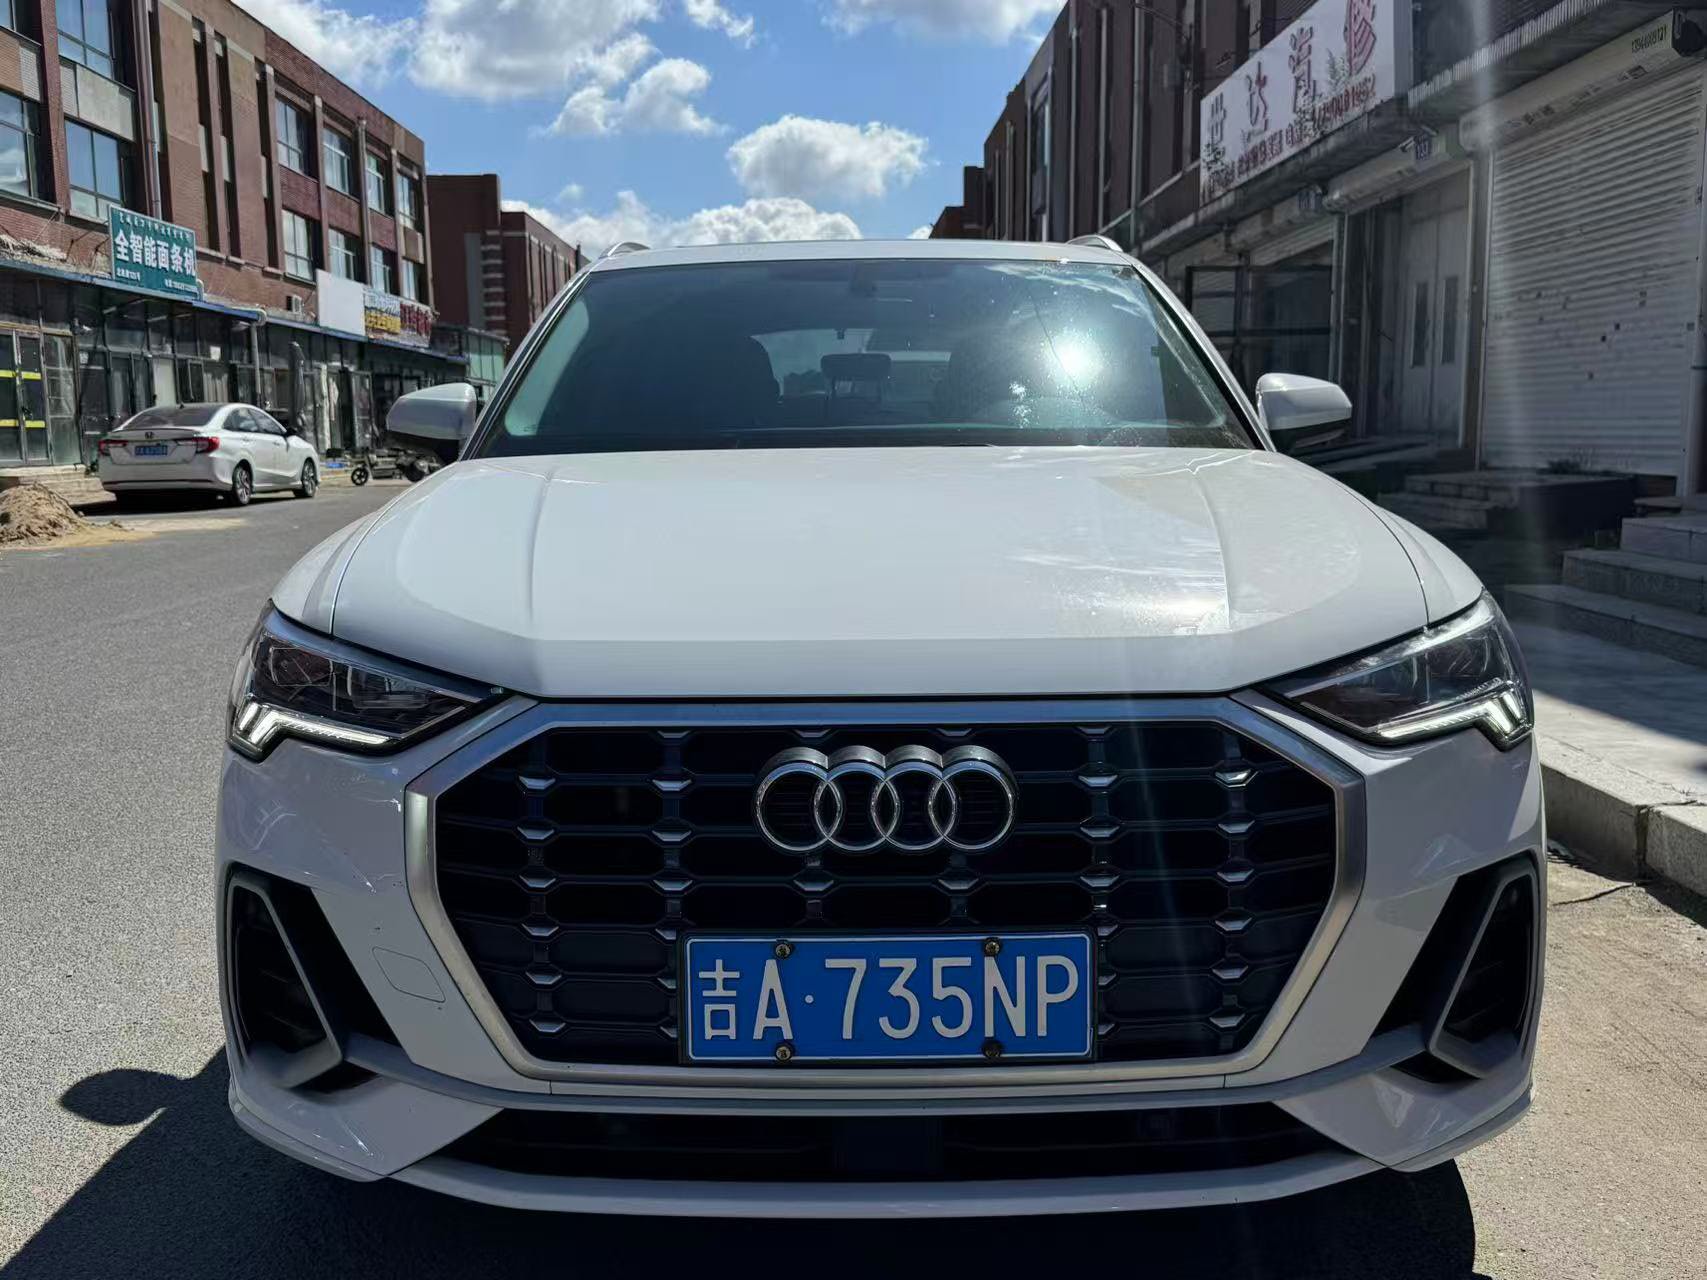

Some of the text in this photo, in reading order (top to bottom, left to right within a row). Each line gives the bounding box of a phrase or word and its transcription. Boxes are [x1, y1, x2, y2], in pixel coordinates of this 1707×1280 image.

[115, 228, 196, 276] 全智能面条机
